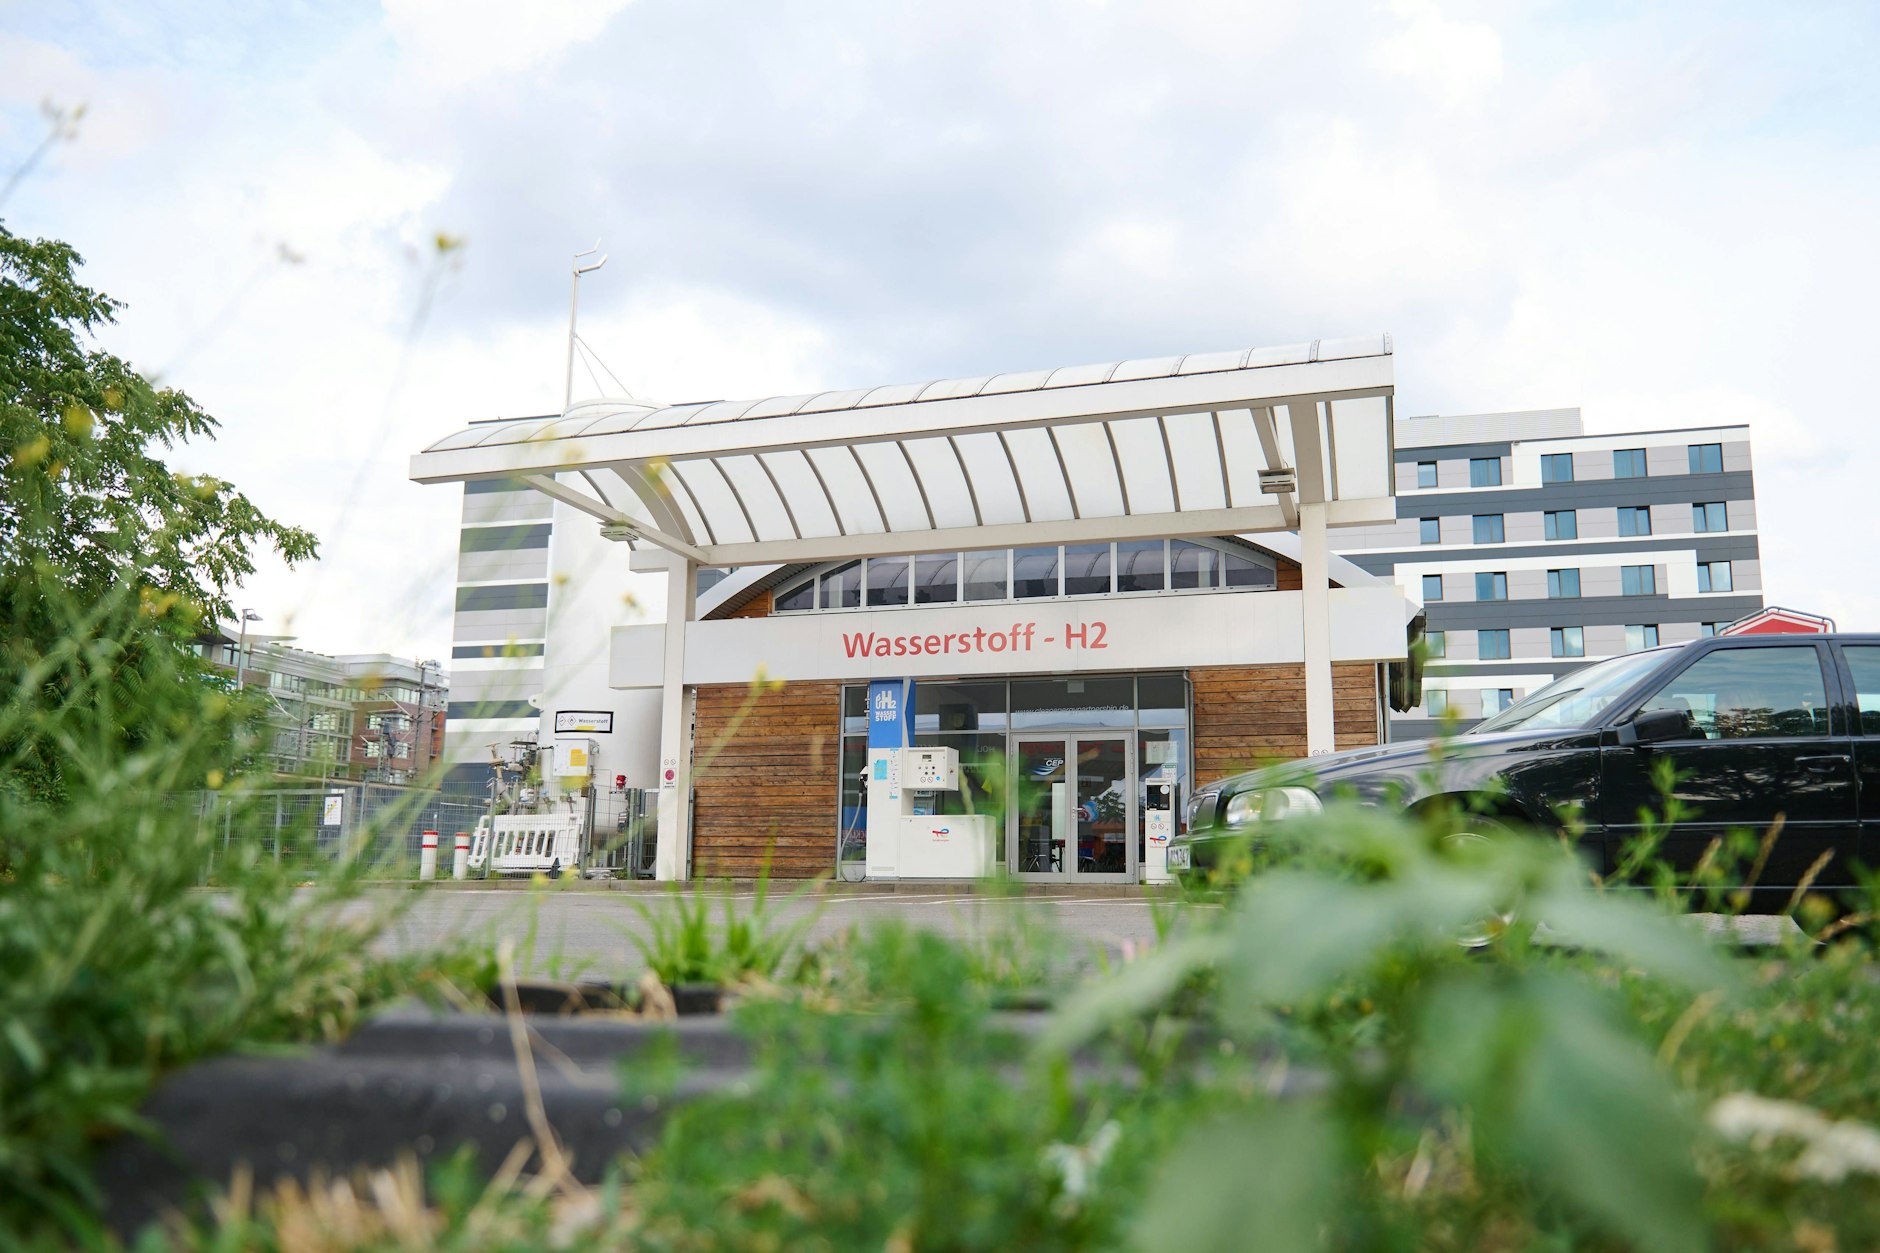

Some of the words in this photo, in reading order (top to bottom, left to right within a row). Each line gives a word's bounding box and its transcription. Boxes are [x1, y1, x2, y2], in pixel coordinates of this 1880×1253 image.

[842, 622, 1036, 658] Wasserstoff
[1065, 621, 1109, 650] H2
[1045, 759, 1064, 767] CEP
